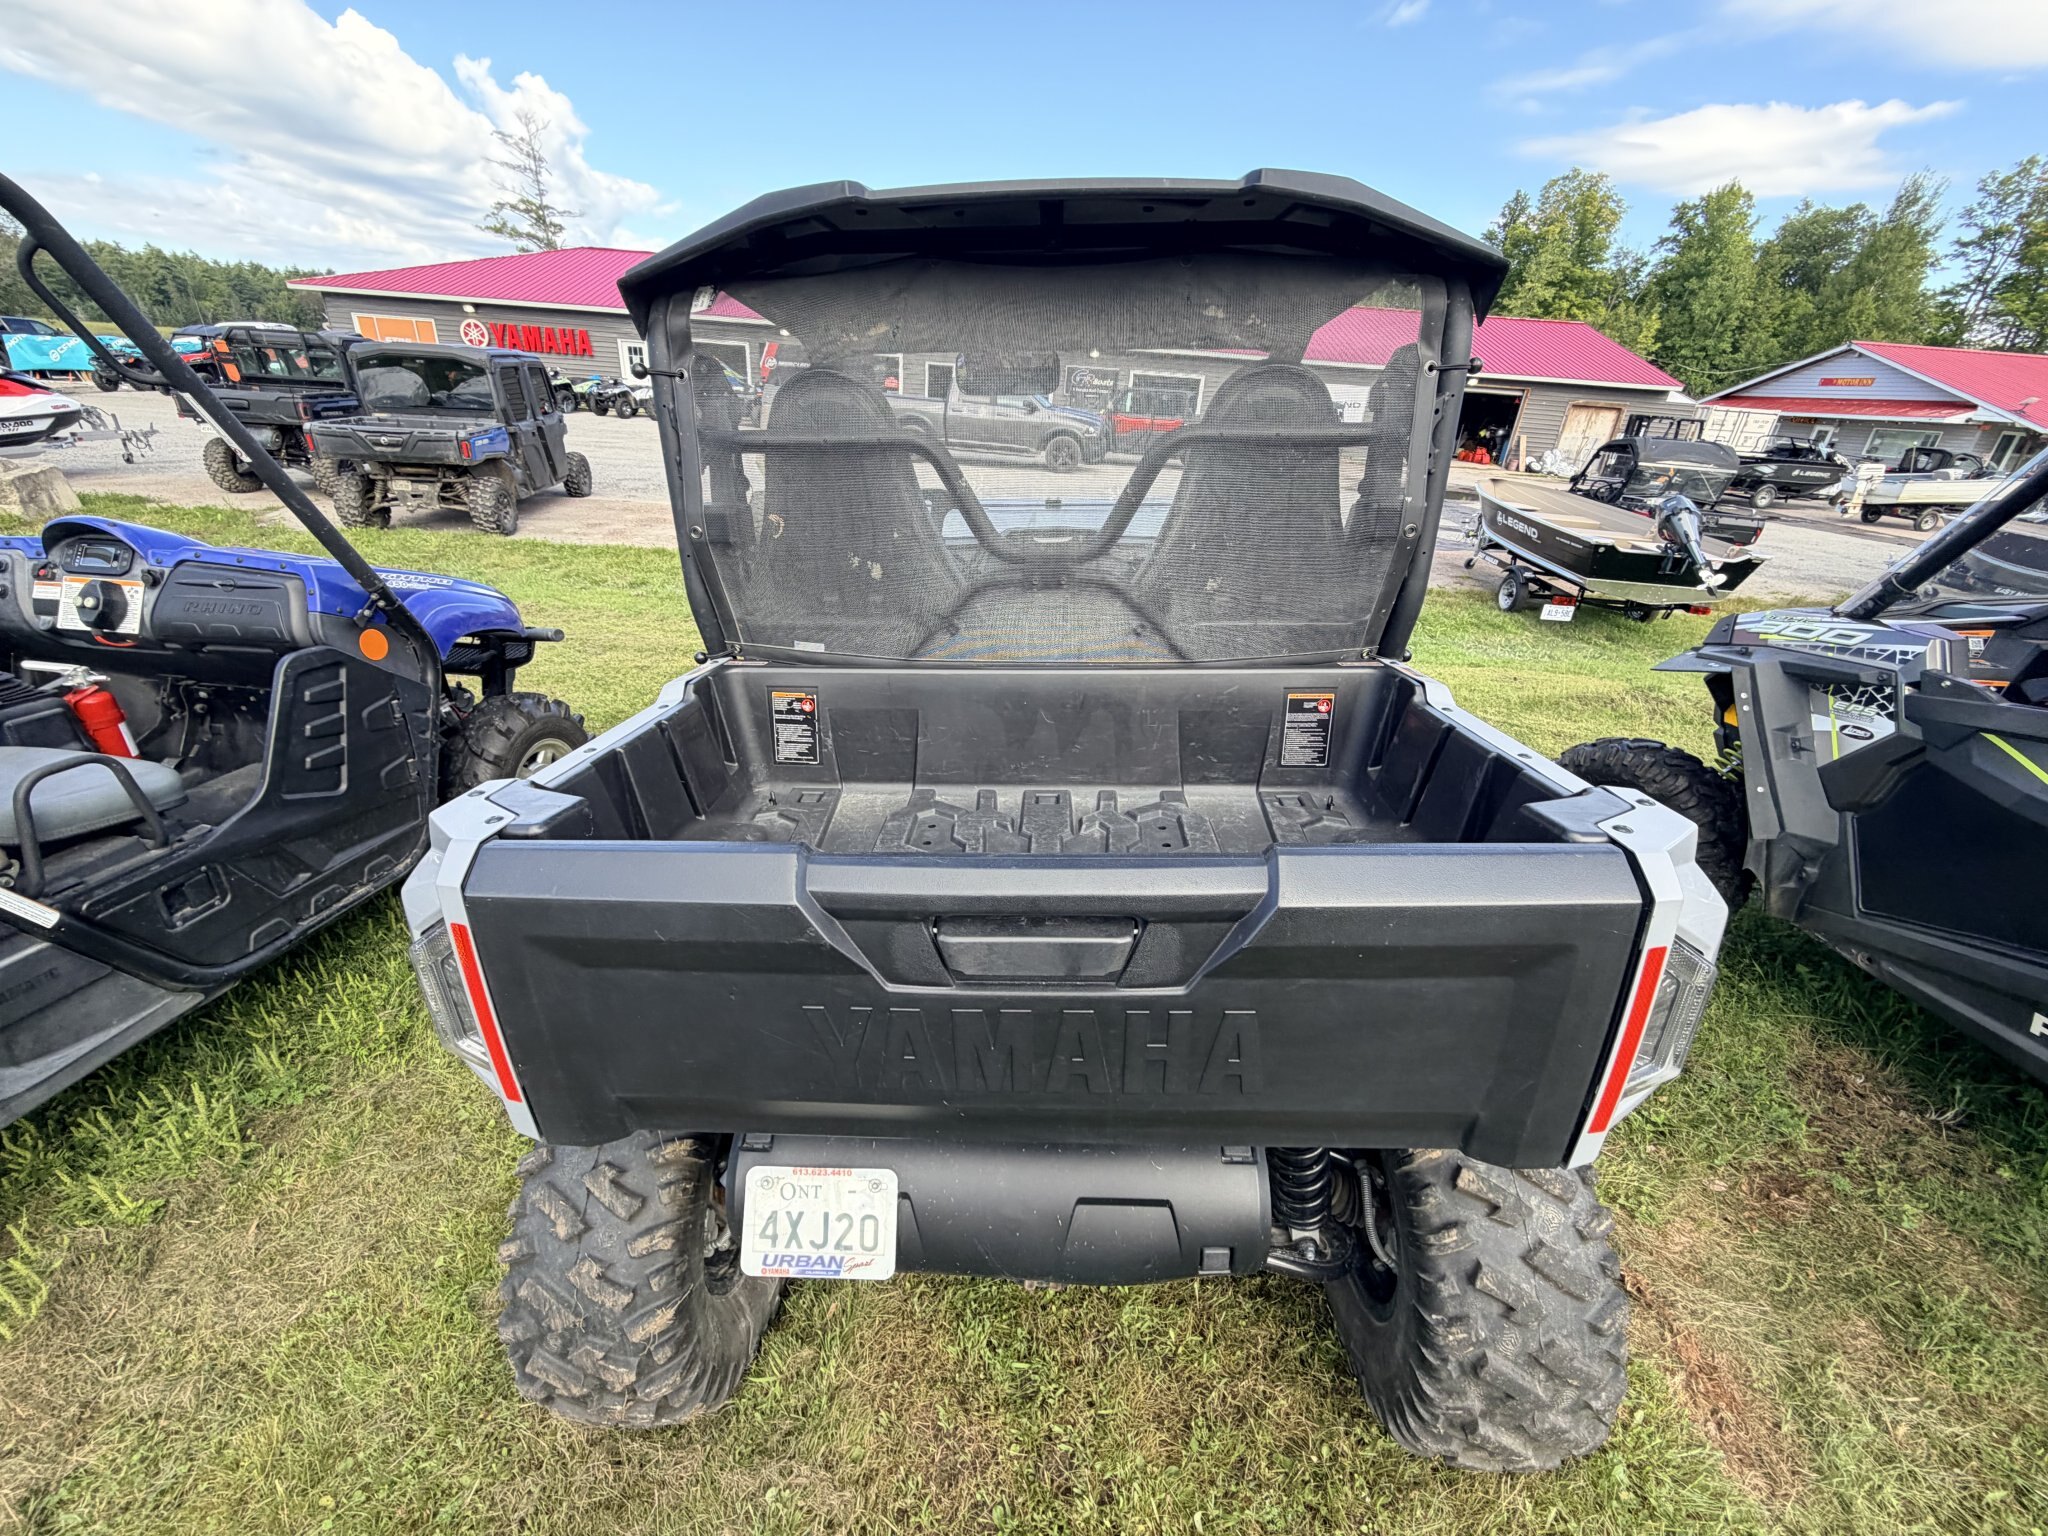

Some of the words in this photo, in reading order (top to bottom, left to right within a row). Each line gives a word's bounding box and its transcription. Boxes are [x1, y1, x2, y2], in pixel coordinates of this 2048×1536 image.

[489, 322, 594, 357] YAMAHA
[1502, 513, 1538, 540] LEGEND
[183, 601, 263, 616] RHINO
[1745, 620, 1875, 647] 900
[1833, 700, 1879, 717] EPS
[802, 1005, 1262, 1095] YAMAHA
[792, 1168, 853, 1177] 613.623.4410
[759, 1210, 879, 1252] 4XJ20
[761, 1253, 845, 1269] URBAN
